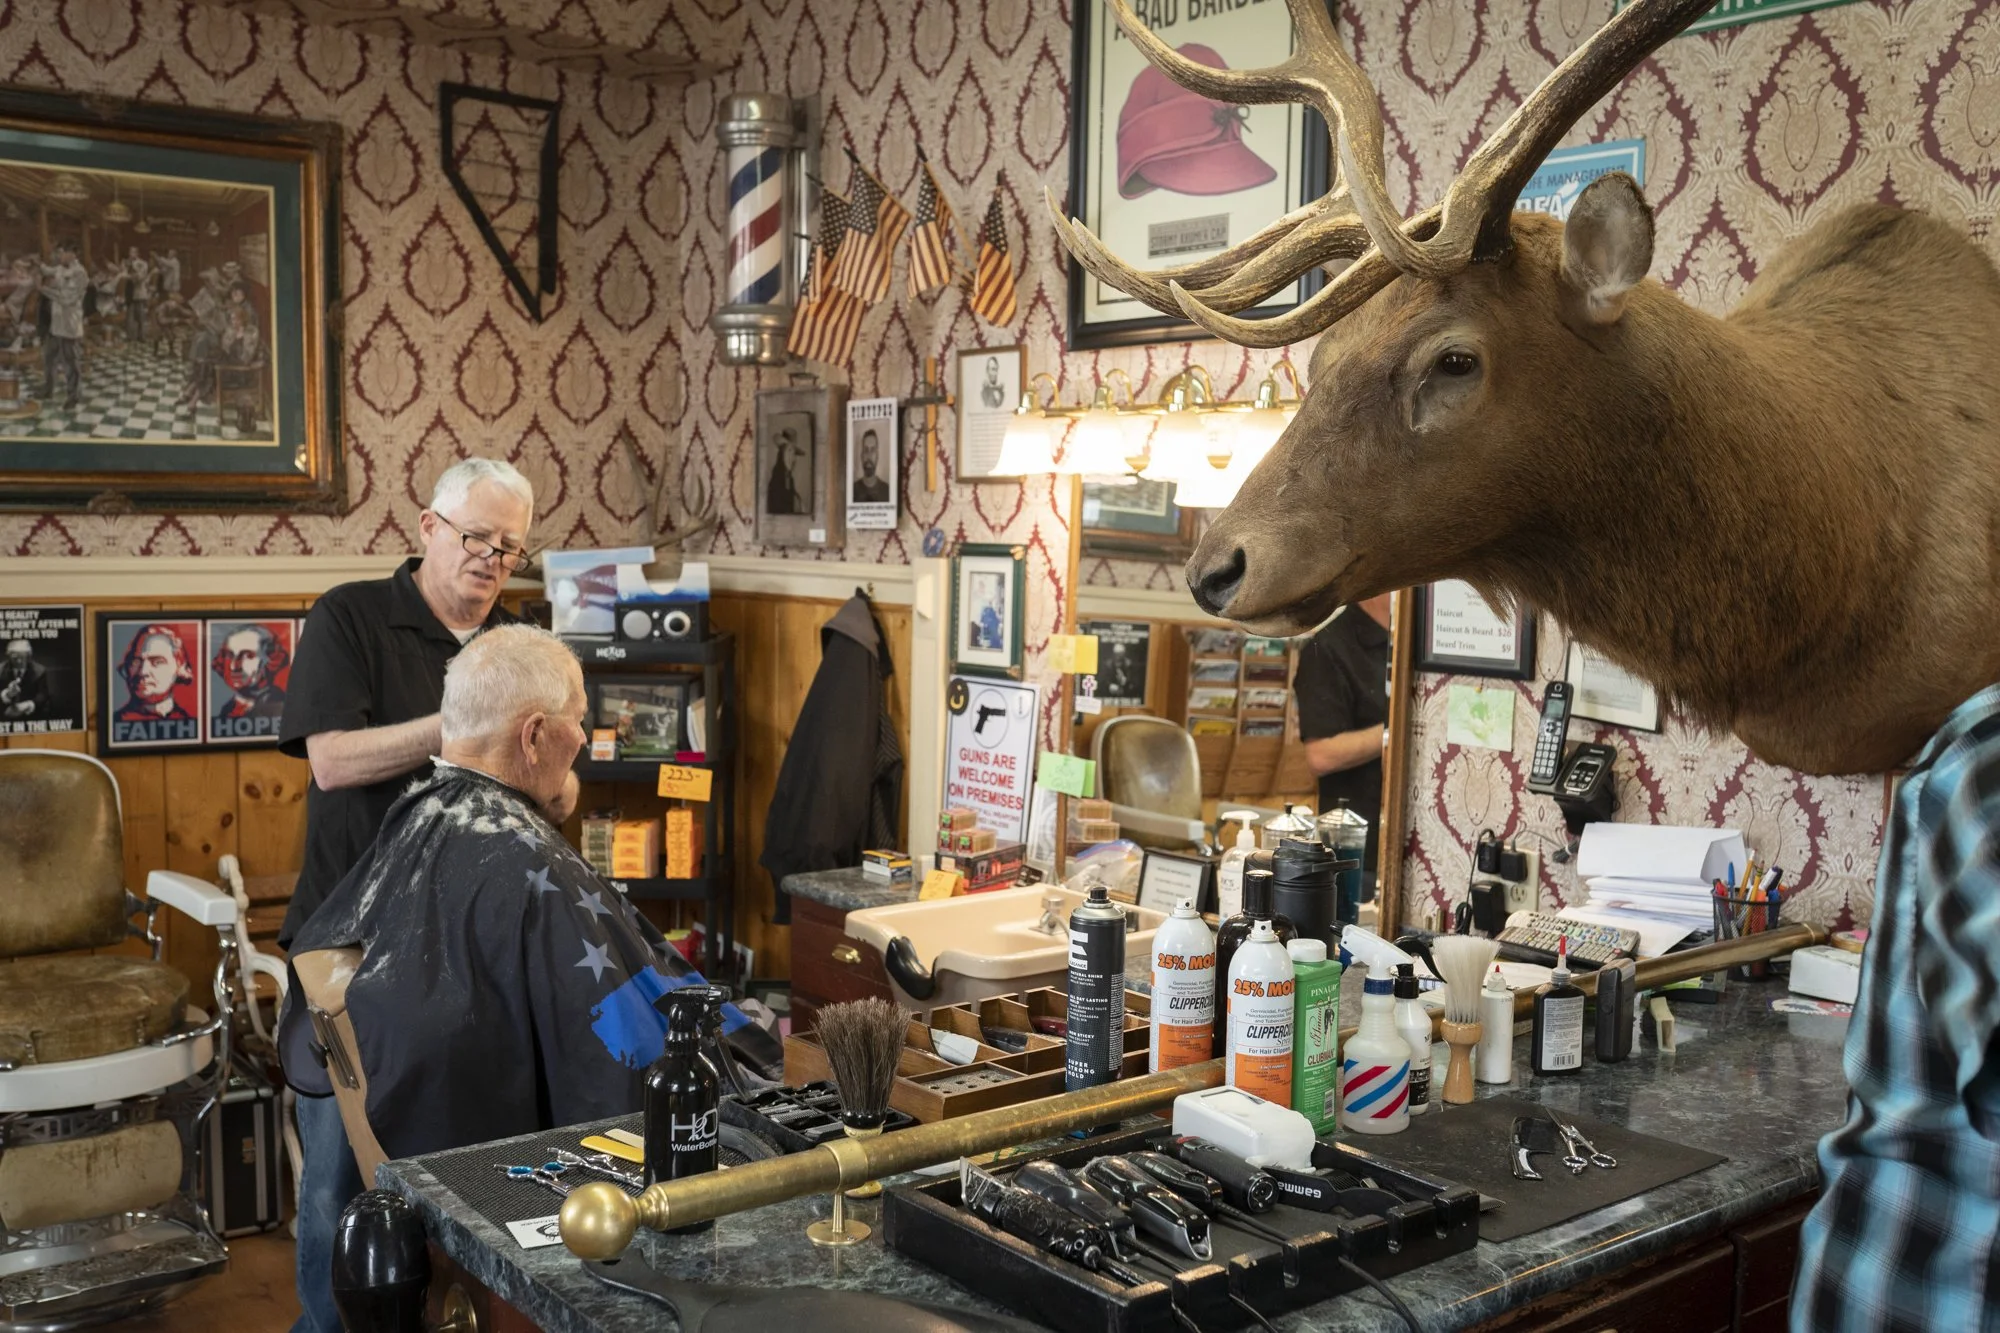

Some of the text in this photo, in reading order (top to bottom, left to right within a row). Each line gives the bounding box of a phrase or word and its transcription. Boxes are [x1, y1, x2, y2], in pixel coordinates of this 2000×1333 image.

[1436, 608, 1464, 619] Haircut
[1436, 624, 1462, 634] Haircut
[1472, 626, 1493, 637] Beard
[1436, 640, 1457, 649] Beard
[1459, 641, 1476, 650] Trim
[27, 720, 47, 732] THE
[48, 718, 73, 731] WAY
[114, 719, 196, 741] FAITH
[213, 716, 281, 737] HOPE
[960, 748, 1016, 770] GUNS ARE
[959, 766, 1014, 789] WELCOME
[949, 782, 964, 798] ON
[967, 787, 1024, 810] PREMISES
[1158, 953, 1186, 970] 25%
[1234, 979, 1264, 997] 25%
[1068, 1059, 1088, 1067] SUPER
[1068, 1064, 1095, 1074] STRONG
[1068, 1071, 1084, 1079] HOLD
